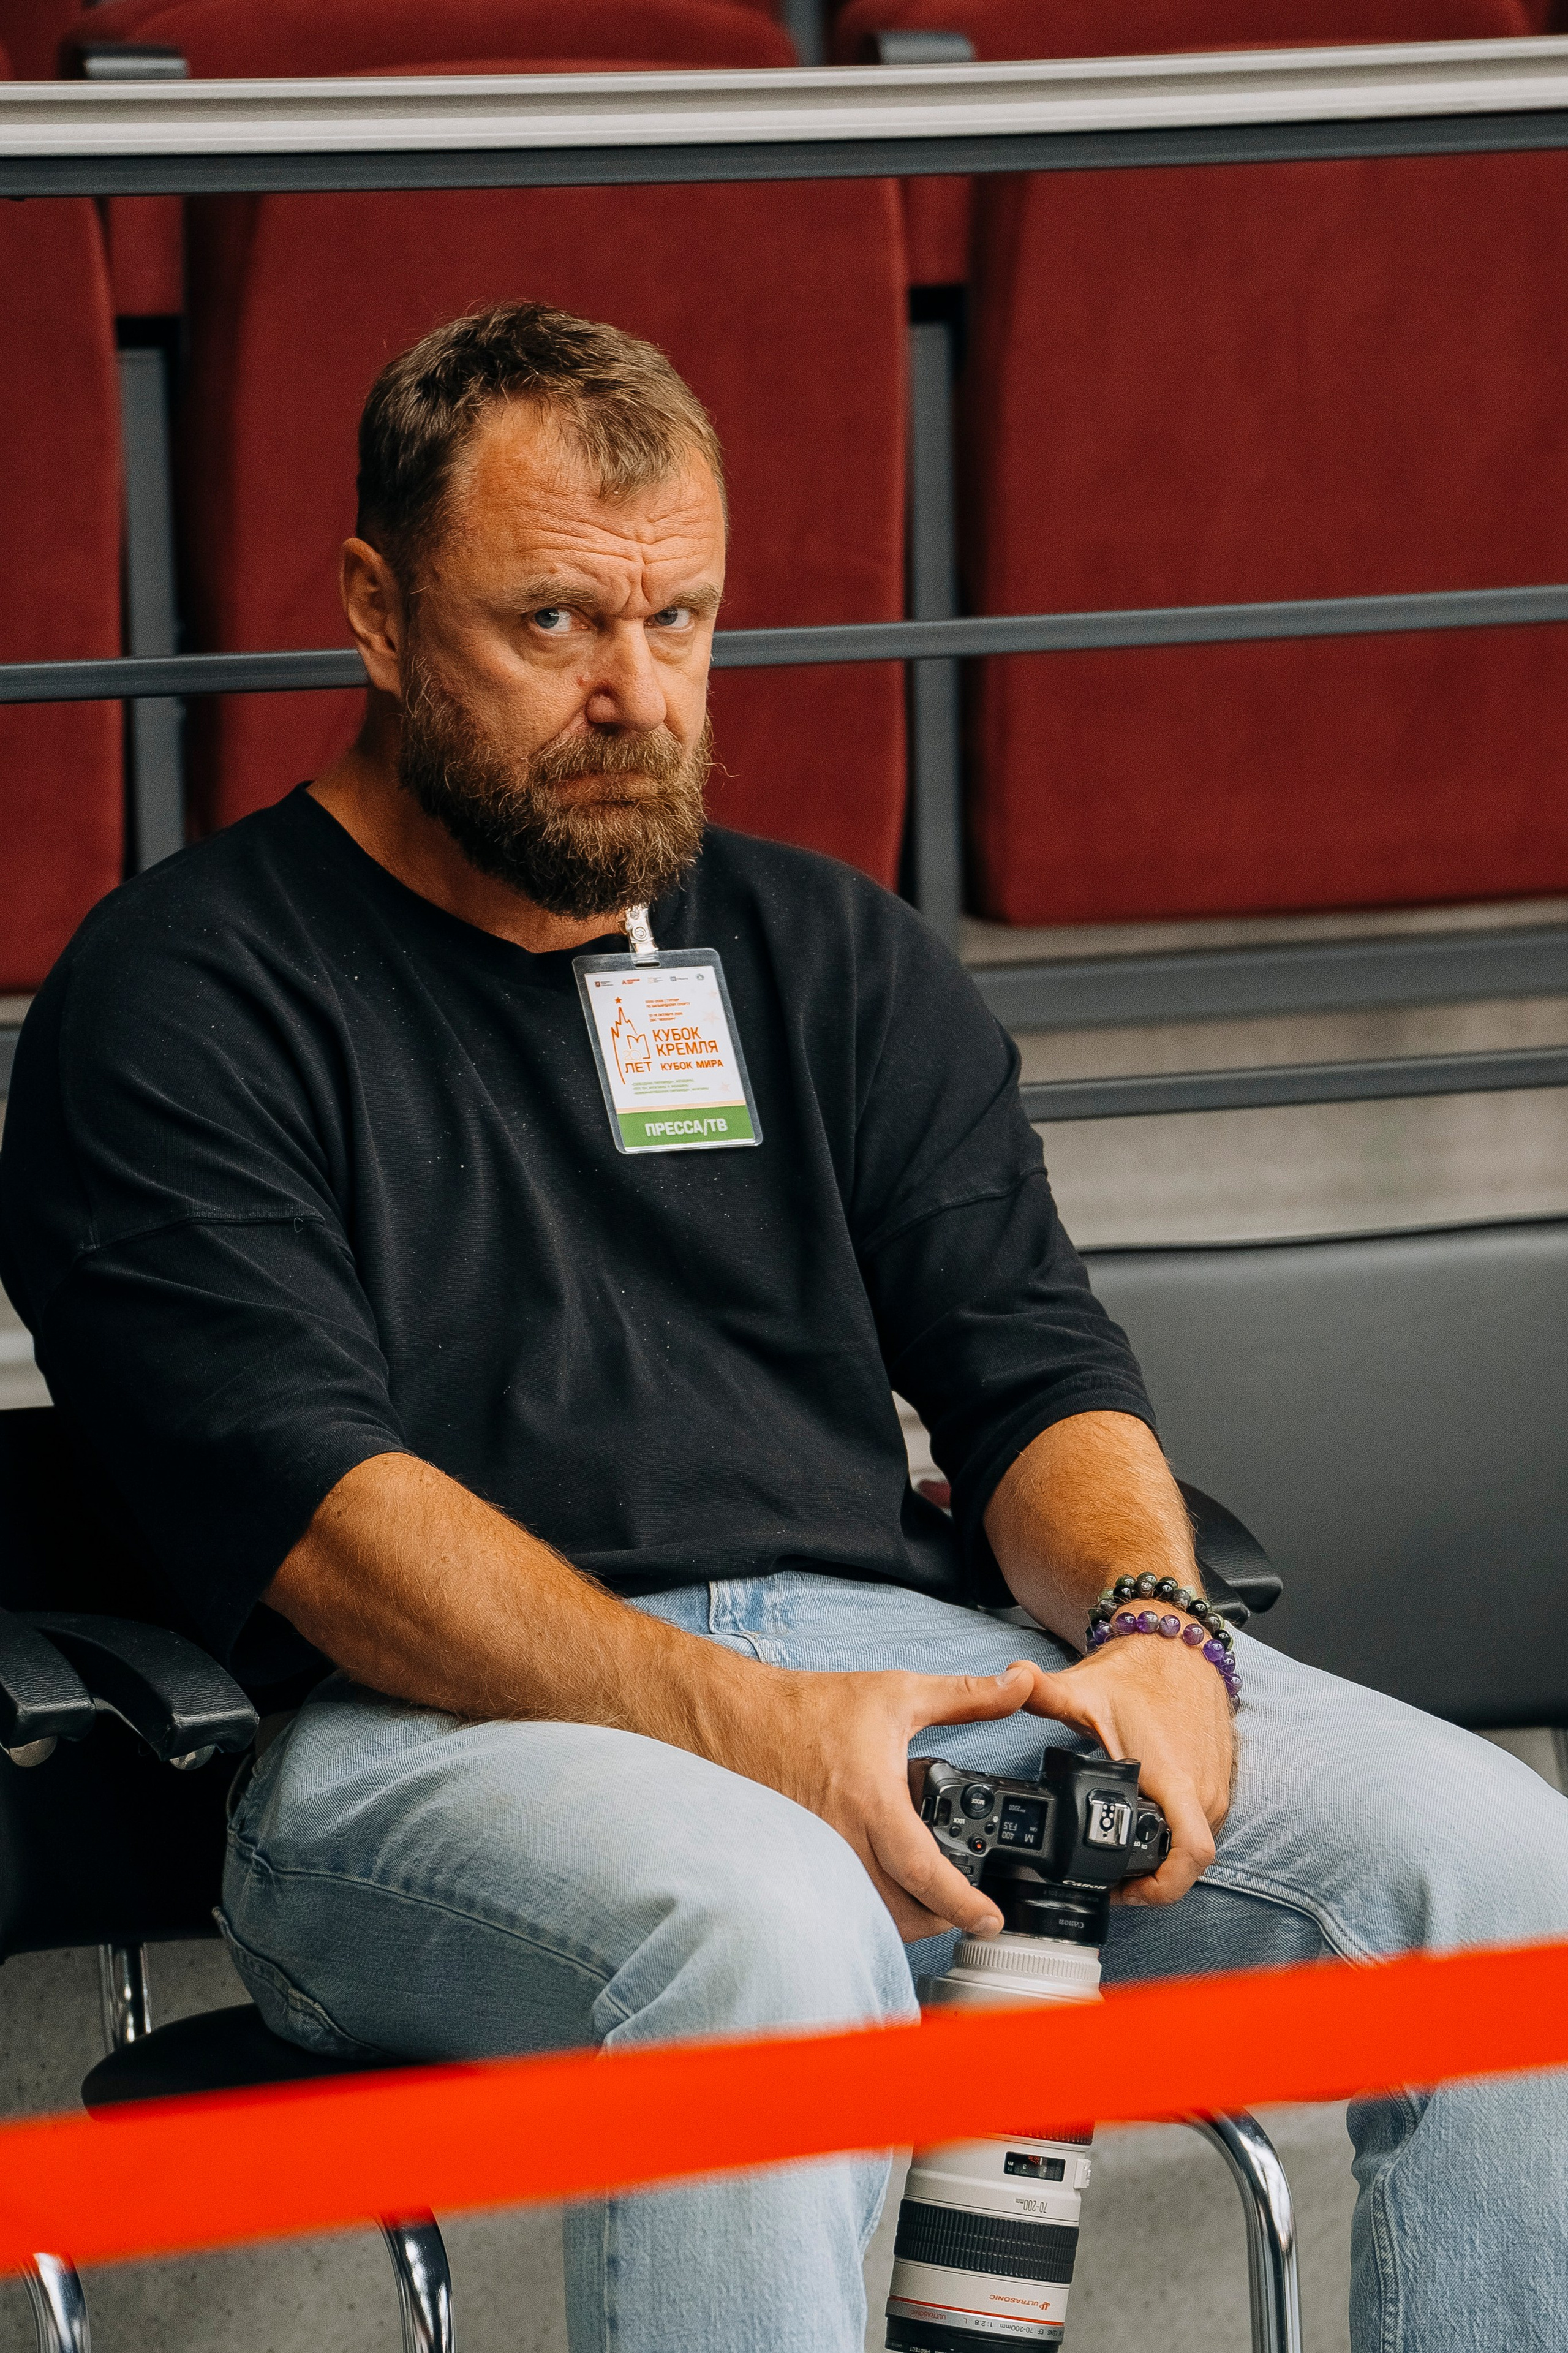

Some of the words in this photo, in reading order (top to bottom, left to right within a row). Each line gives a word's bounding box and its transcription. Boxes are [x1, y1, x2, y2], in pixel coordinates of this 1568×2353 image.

[652, 1027, 701, 1042] КУБОК
[655, 1040, 718, 1057] КРЕМЛЯ
[625, 1062, 652, 1073] ЛЕТ
[660, 1062, 693, 1071] КУБОК
[696, 1060, 723, 1068] МИРА
[644, 1119, 728, 1136] ПРЕССА/ТВ
[1024, 1834, 1034, 1843] M
[1061, 1879, 1107, 1890] Canon
[1058, 1918, 1084, 1930] Canon
[1016, 2198, 1047, 2213] 70-200mm
[989, 2294, 1039, 2307] ULTRASONIC
[908, 2310, 946, 2320] ULTRASONIC
[1000, 2323, 1033, 2333] 70-200mm
